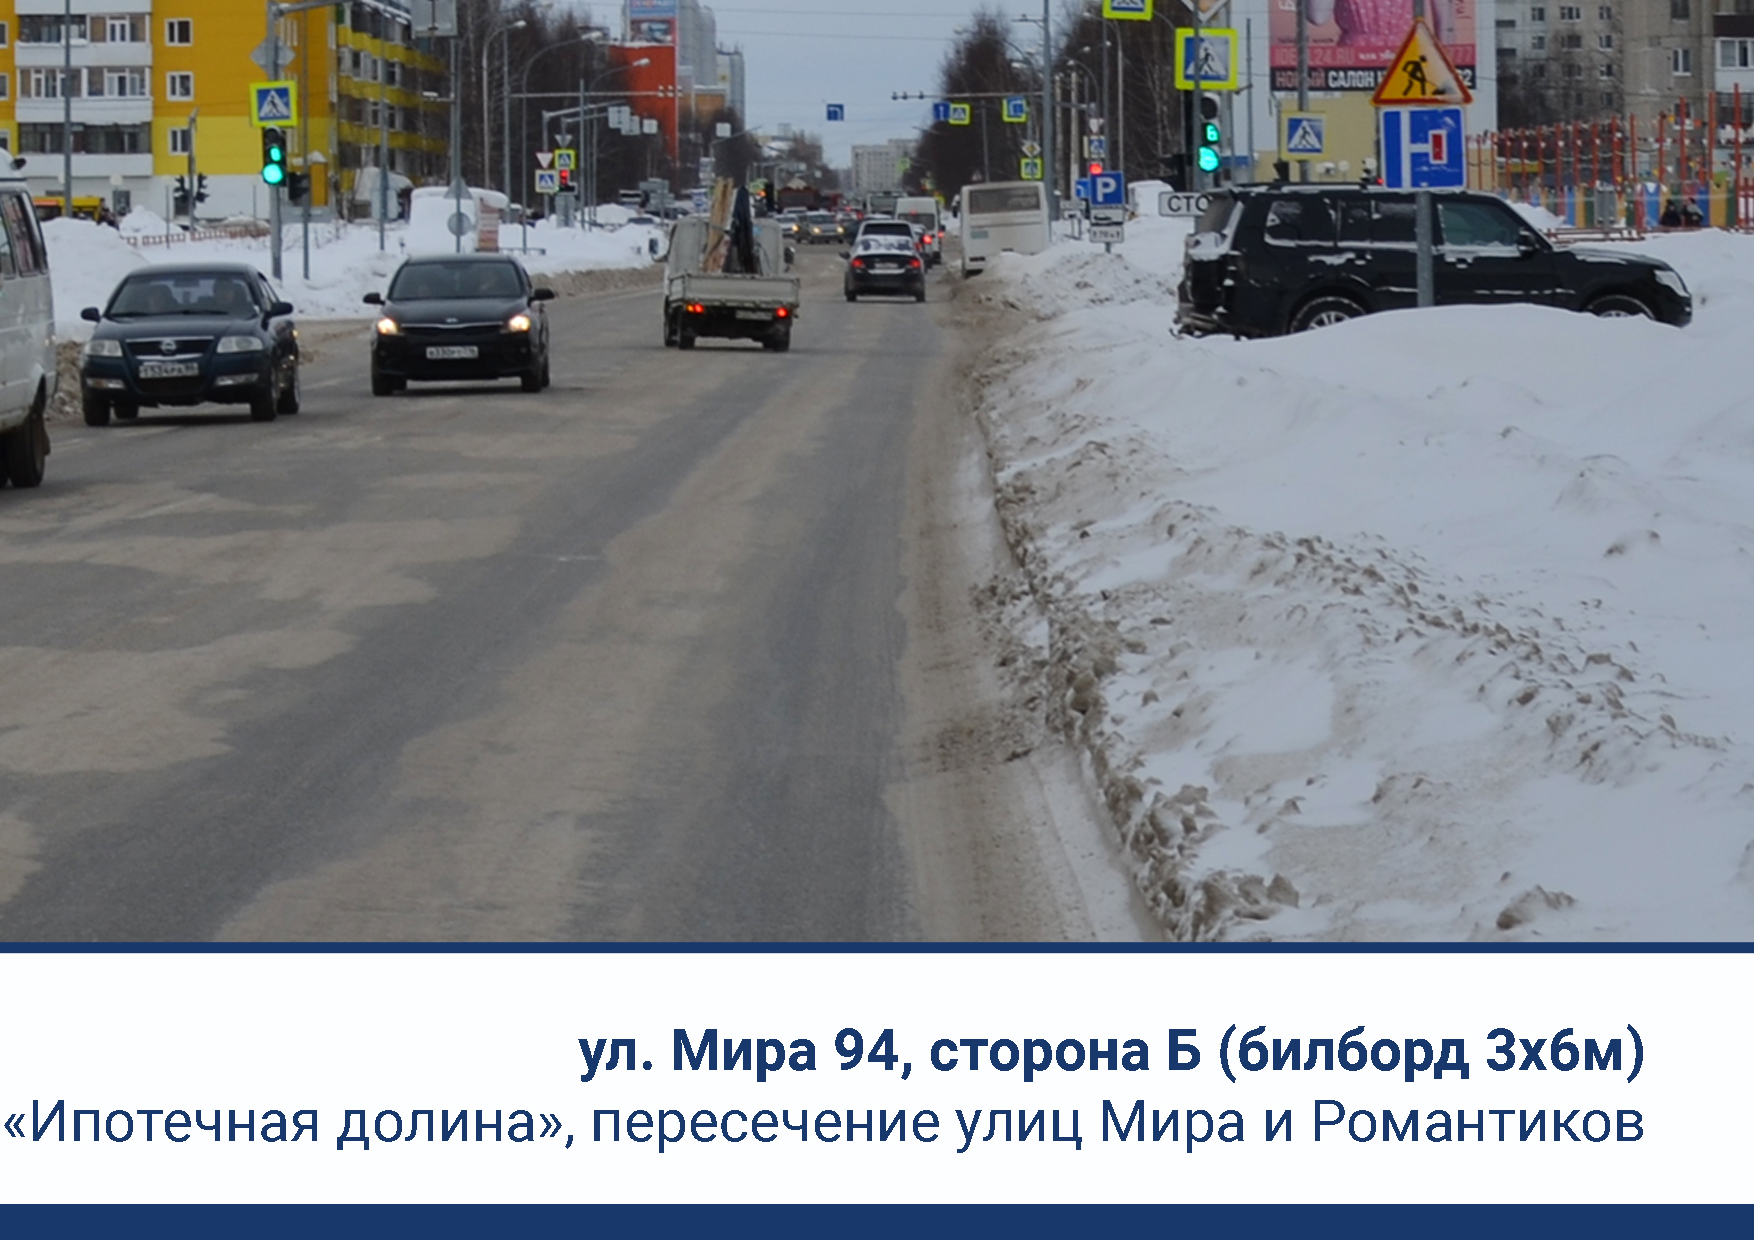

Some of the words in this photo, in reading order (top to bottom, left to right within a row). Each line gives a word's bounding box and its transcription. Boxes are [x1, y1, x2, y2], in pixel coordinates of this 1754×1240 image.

[1275, 47, 1355, 65] IDEL24.RU
[1275, 69, 1326, 89] НОЫЙ
[1328, 70, 1375, 88] САЛОН
[1098, 176, 1117, 203] P
